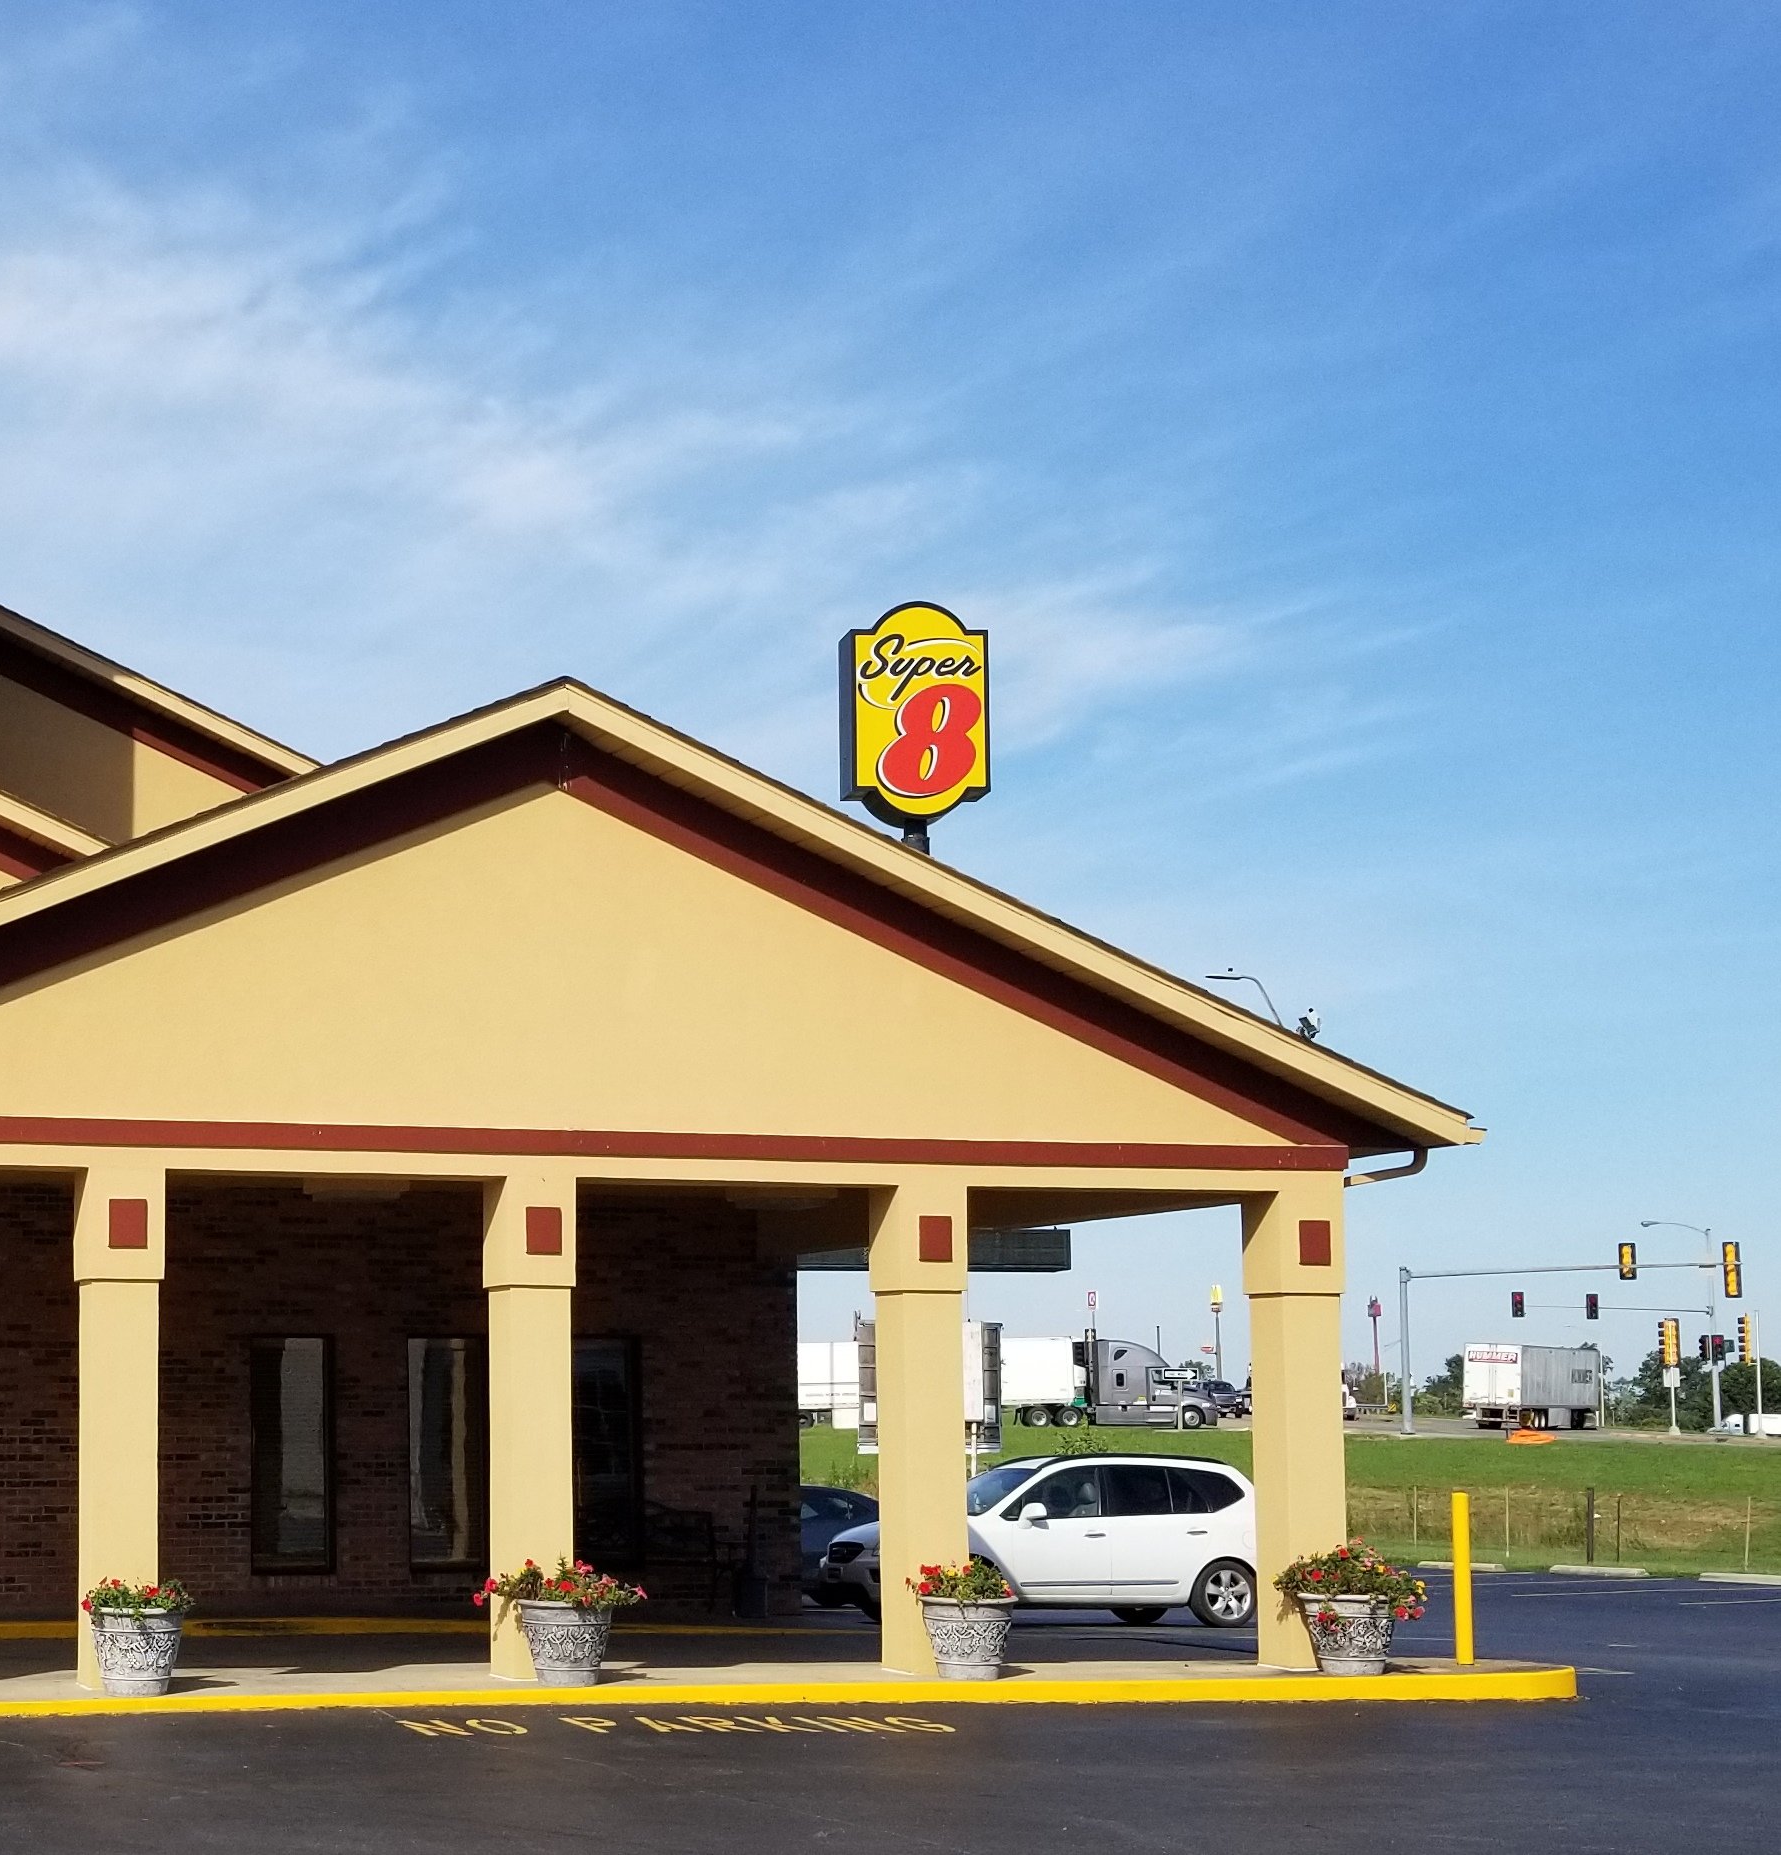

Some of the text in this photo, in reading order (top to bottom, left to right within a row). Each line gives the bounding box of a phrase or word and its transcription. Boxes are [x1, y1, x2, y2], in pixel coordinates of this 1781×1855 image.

[859, 633, 982, 702] Super
[876, 683, 982, 798] 8
[1468, 1350, 1517, 1362] HUMMER
[395, 1715, 957, 1736] NO PARKING
